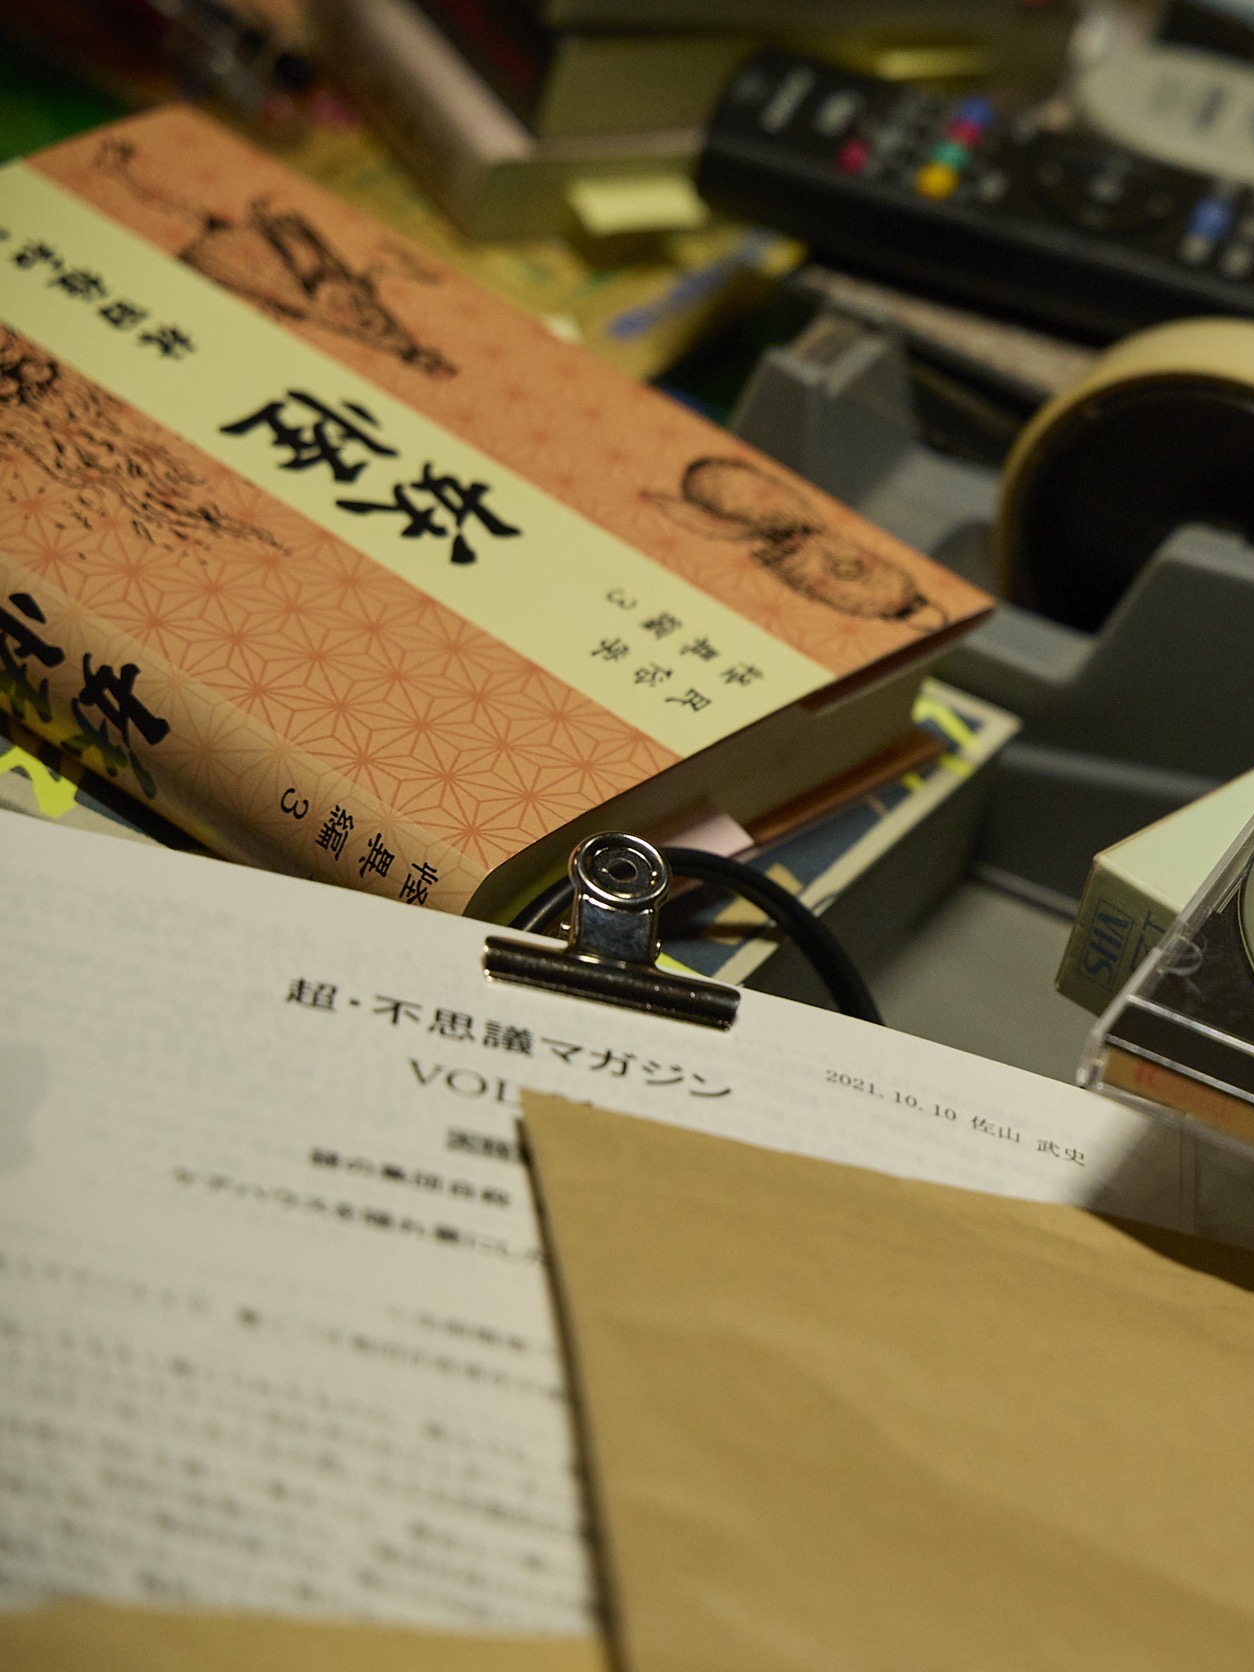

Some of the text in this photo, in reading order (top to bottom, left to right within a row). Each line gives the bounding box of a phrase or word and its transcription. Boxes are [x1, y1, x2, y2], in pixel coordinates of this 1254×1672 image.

[219, 388, 522, 565] 妖怪
[590, 637, 713, 712] 民俗学
[1083, 911, 1130, 985] VHS
